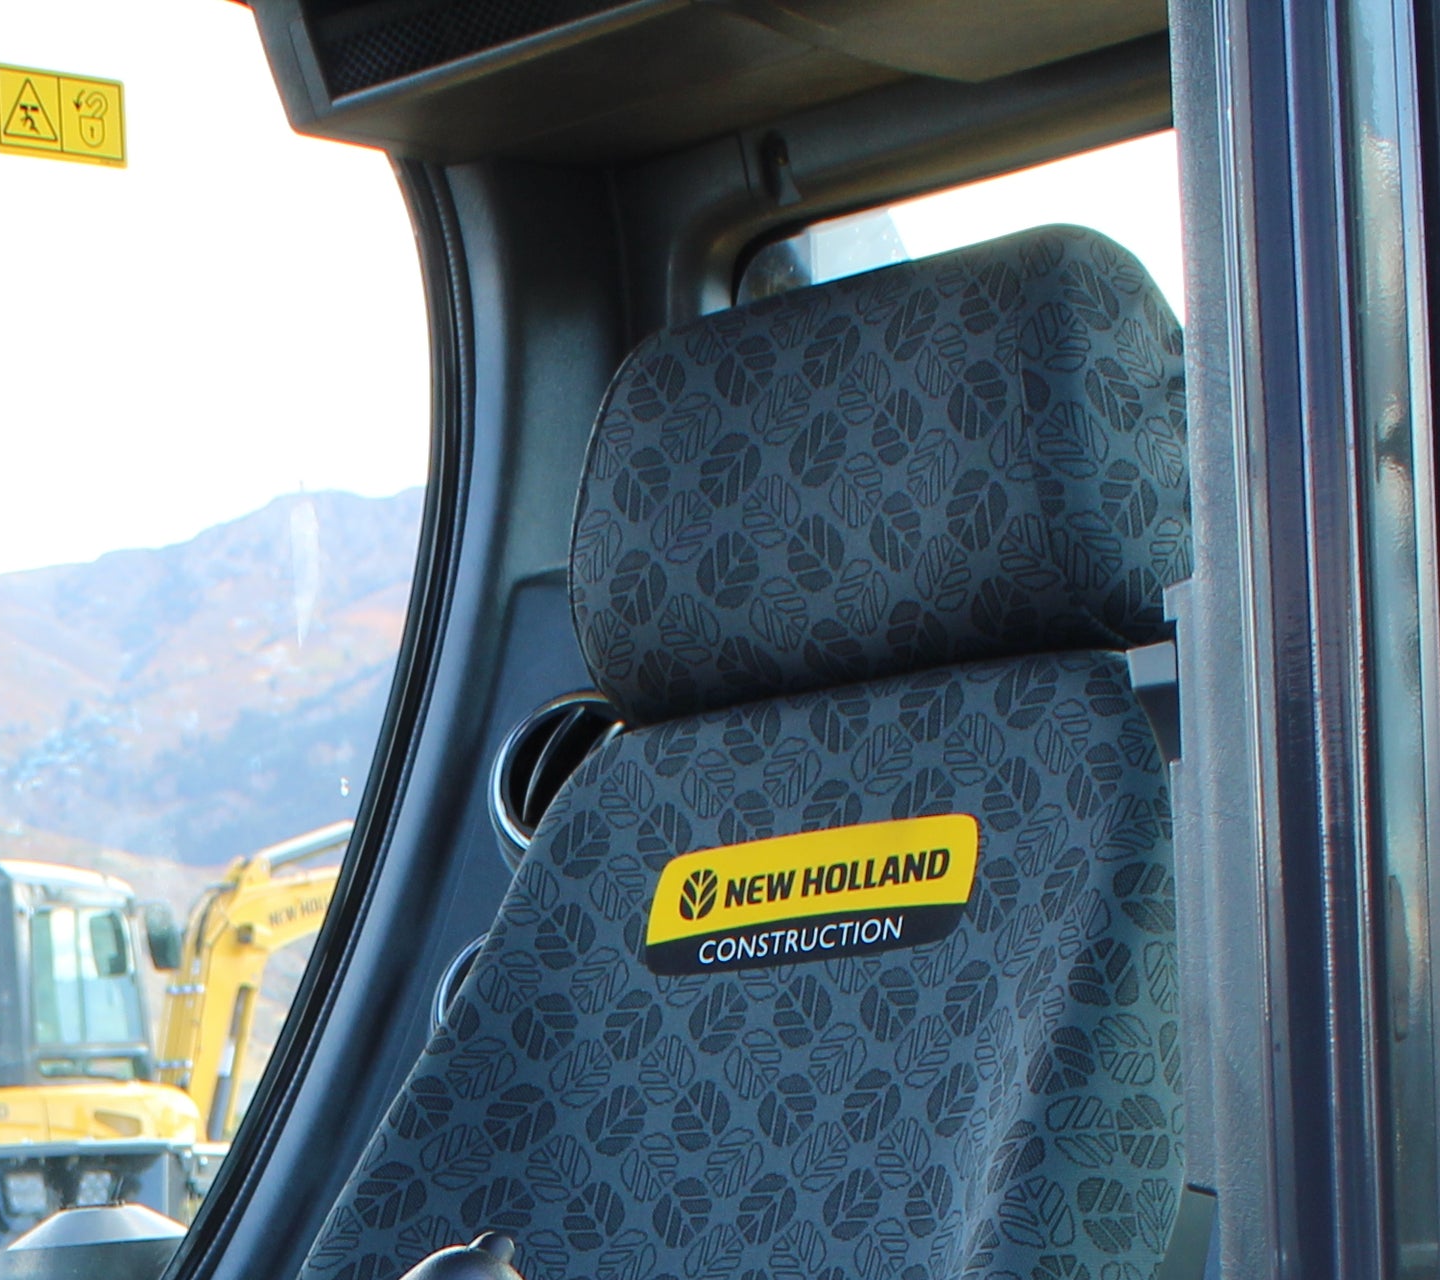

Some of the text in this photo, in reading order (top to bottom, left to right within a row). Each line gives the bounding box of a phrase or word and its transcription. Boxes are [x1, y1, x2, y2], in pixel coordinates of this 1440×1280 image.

[723, 848, 951, 910] NEW HOLLAND
[697, 916, 904, 965] CONSTRUCTION
